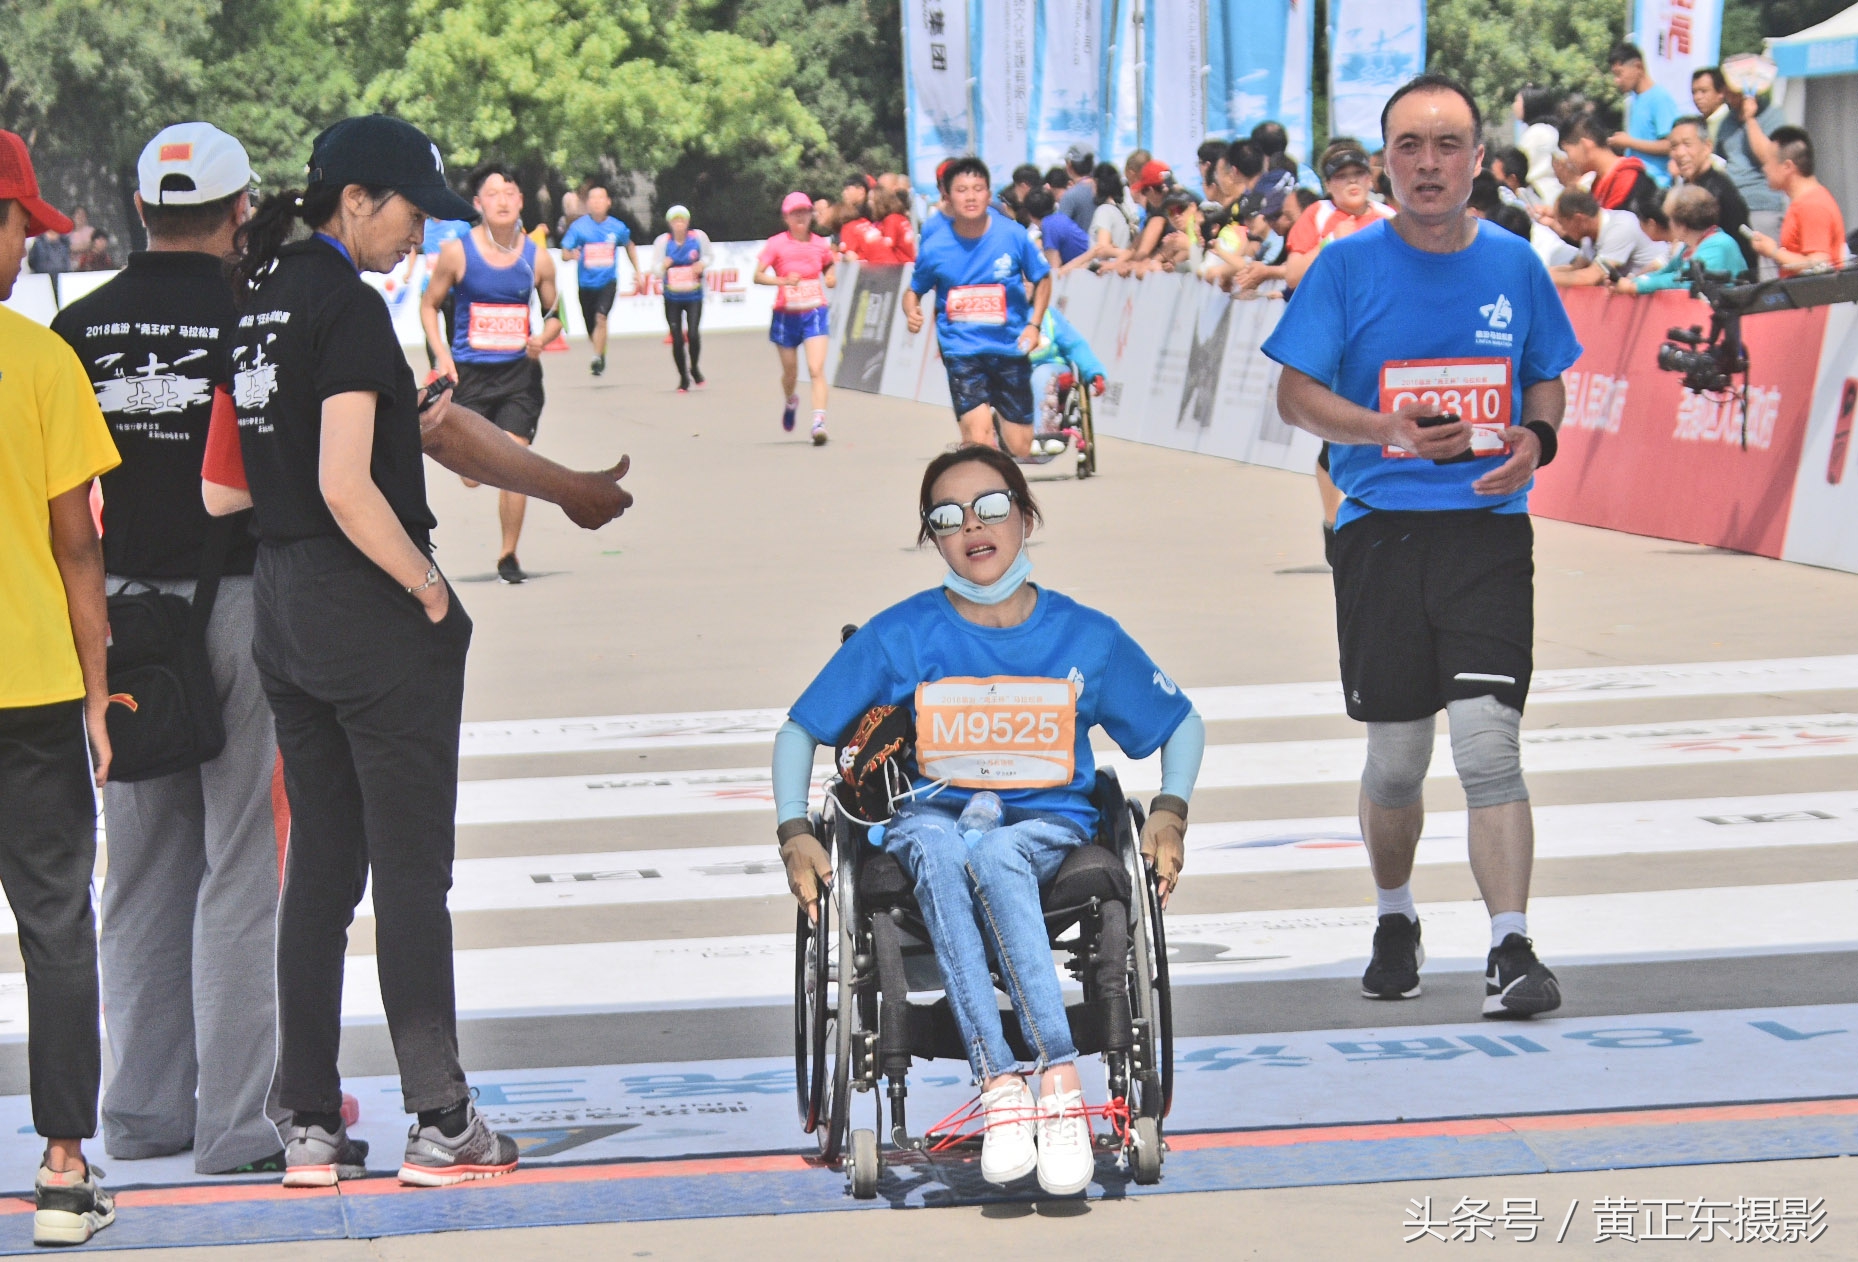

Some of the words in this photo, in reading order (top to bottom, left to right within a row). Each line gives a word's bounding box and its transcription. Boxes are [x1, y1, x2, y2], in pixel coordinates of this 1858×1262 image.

[951, 296, 1001, 312] C2253
[475, 317, 524, 333] C2080
[932, 712, 1060, 744] M9525
